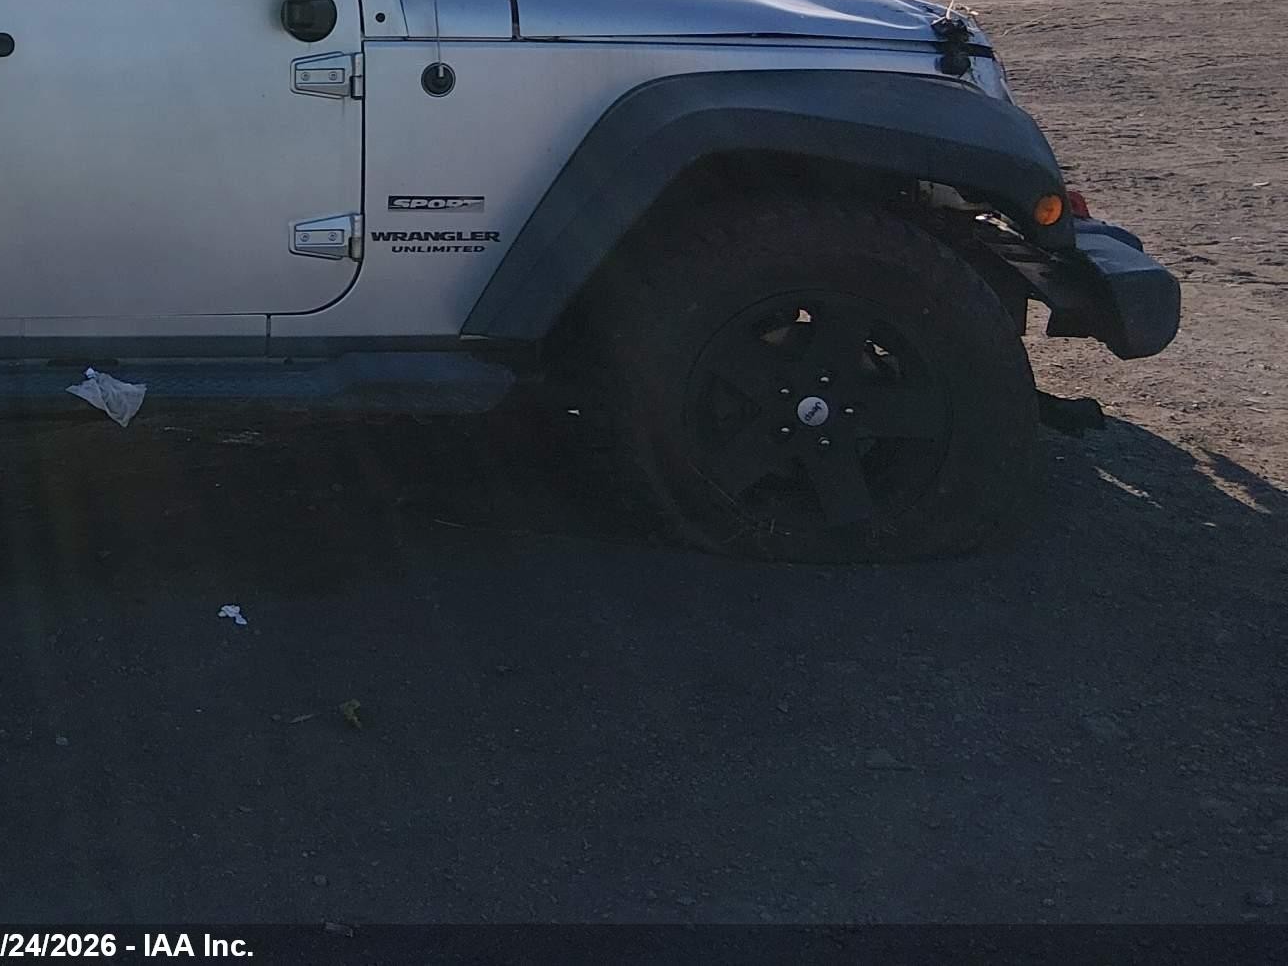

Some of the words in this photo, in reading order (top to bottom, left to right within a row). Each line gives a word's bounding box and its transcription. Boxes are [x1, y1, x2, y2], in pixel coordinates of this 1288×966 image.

[392, 197, 483, 209] SPORT
[371, 231, 501, 242] WRANGLER
[391, 245, 486, 253] UNLIMITED
